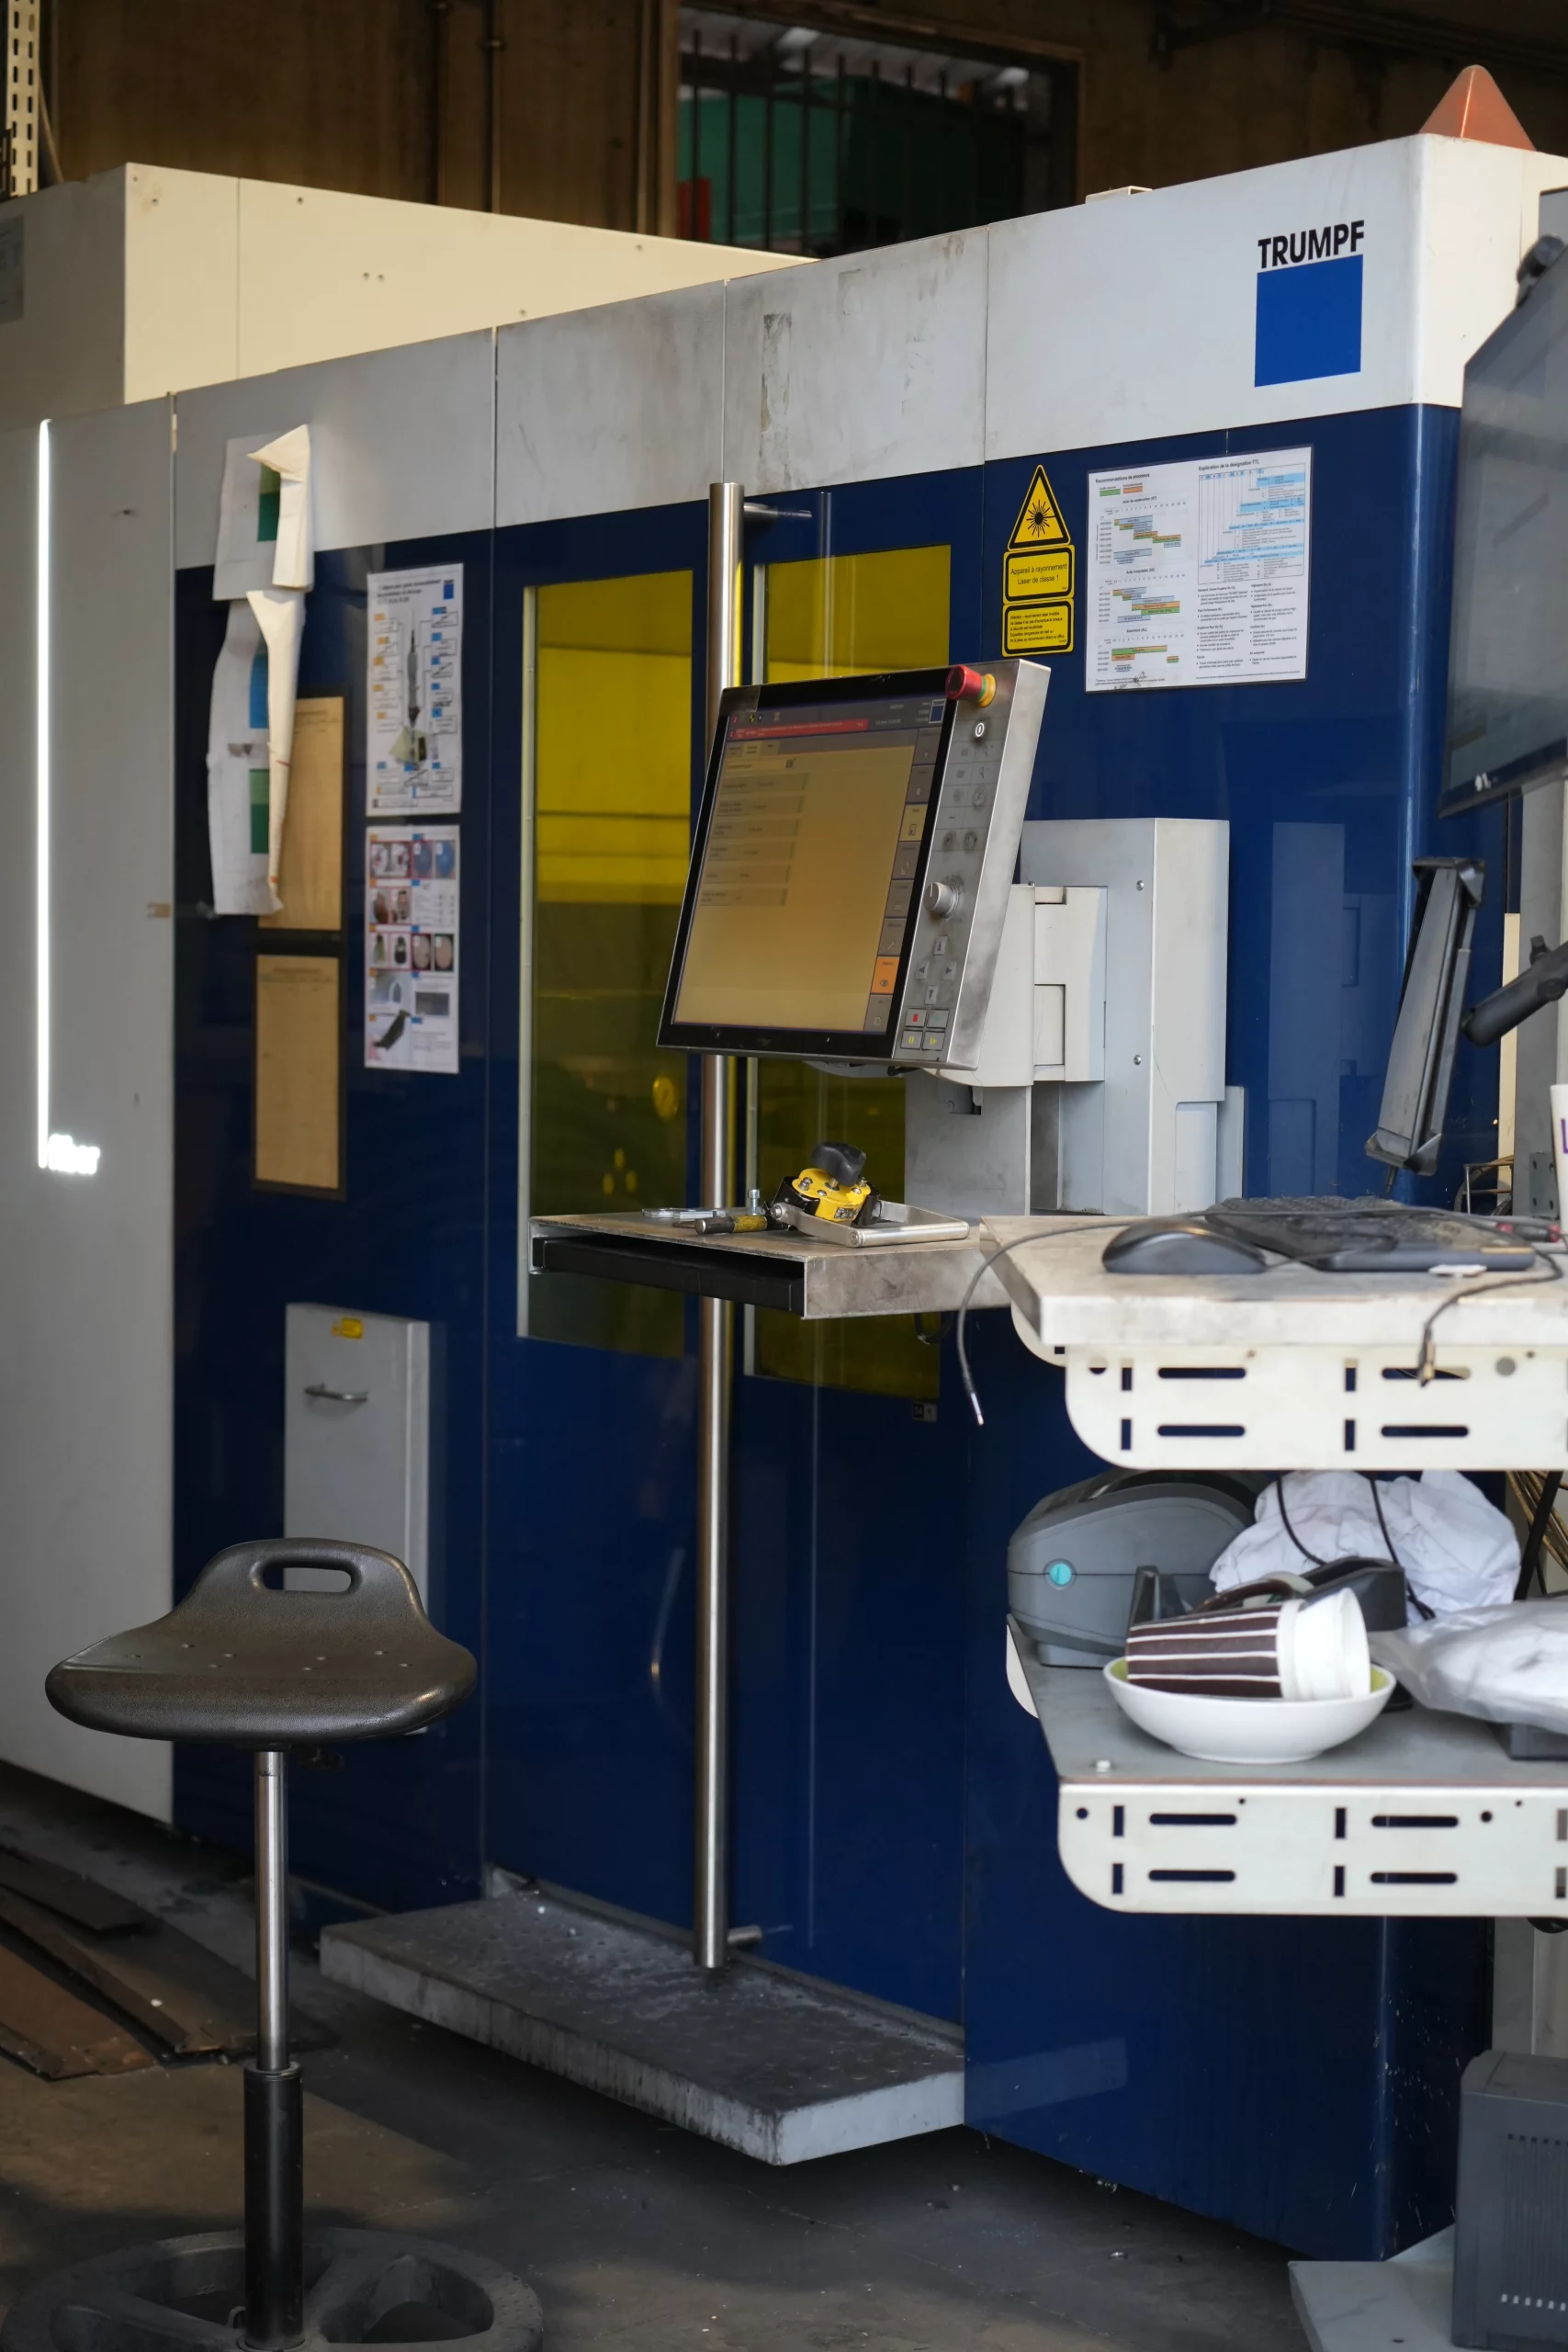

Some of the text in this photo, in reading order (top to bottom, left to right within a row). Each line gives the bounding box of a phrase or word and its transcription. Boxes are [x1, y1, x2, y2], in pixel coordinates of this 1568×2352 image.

[1258, 220, 1365, 269] TRUMPF
[1011, 566, 1030, 575] Appareil
[1036, 563, 1067, 573] rayonnement
